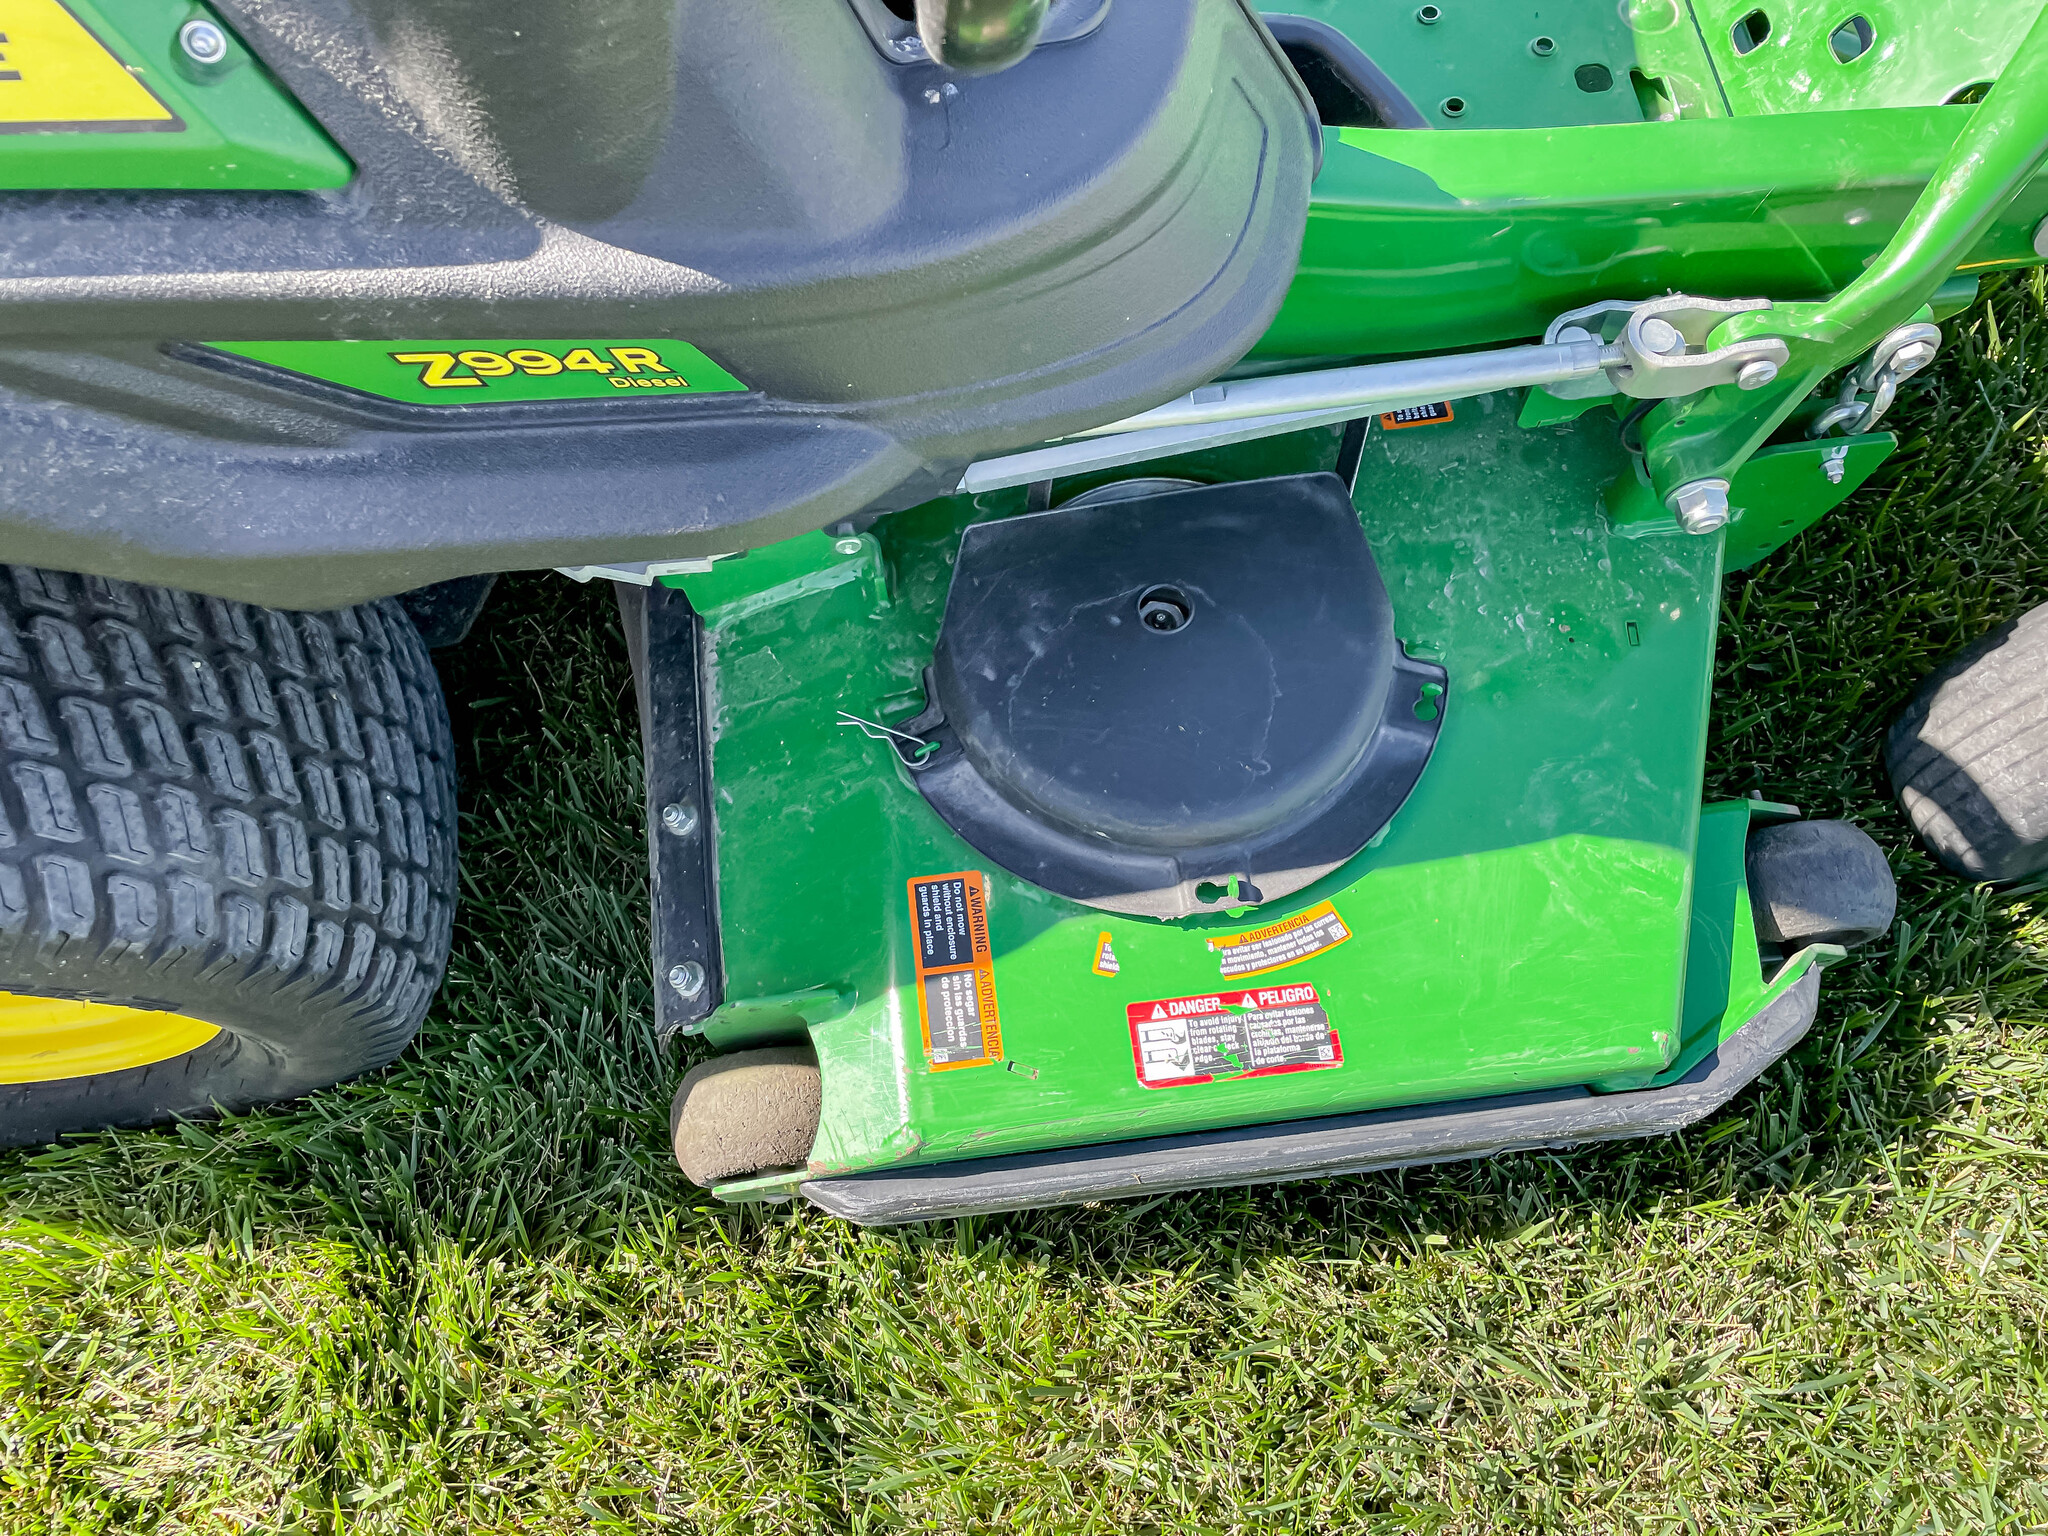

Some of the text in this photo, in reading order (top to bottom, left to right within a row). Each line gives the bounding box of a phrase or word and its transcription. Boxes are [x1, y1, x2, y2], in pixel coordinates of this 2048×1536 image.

[390, 346, 676, 388] Z994R
[607, 375, 690, 389] Diesel
[918, 886, 931, 917] guards
[931, 884, 944, 931] shield and
[953, 881, 966, 936] Do not mow
[942, 882, 958, 960] without enclosure
[970, 897, 988, 953] WARNING
[1249, 914, 1310, 942] ADVERTENCIA
[923, 930, 934, 955] place
[1232, 944, 1250, 955] evitar
[1251, 942, 1262, 950] ser
[1263, 932, 1293, 948] lesionado
[1293, 928, 1304, 940] por
[1304, 924, 1314, 933] las
[1313, 912, 1337, 930] correas
[1227, 949, 1267, 964] movimiento,
[1267, 939, 1297, 955] mantener
[1297, 931, 1314, 943] todos
[1314, 928, 1325, 938] los
[1246, 963, 1251, 972] y
[1251, 953, 1287, 970] protectores
[1287, 949, 1296, 958] en
[1295, 947, 1304, 956] su
[1304, 940, 1323, 955] lugar.
[941, 977, 950, 989] de
[963, 973, 976, 1017] No segar
[1258, 986, 1314, 1006] PELIGRO
[952, 975, 968, 1049] sin las guardas
[1168, 997, 1221, 1016] DANGER
[1247, 1006, 1315, 1021] Para evitar lesiones
[980, 981, 1001, 1060] ADVERTENCIA
[1188, 1014, 1242, 1028] To avoid injury
[1190, 1024, 1238, 1037] from rotating
[1282, 1018, 1295, 1028] por
[1294, 1016, 1306, 1025] las
[1284, 1023, 1326, 1035] mantenerse
[1191, 1033, 1236, 1046] blades, stay
[1192, 1044, 1212, 1054] clear
[1280, 1035, 1293, 1044] del
[1315, 1032, 1325, 1041] de
[1254, 1044, 1301, 1057] la plataforma
[1255, 1057, 1265, 1065] de
